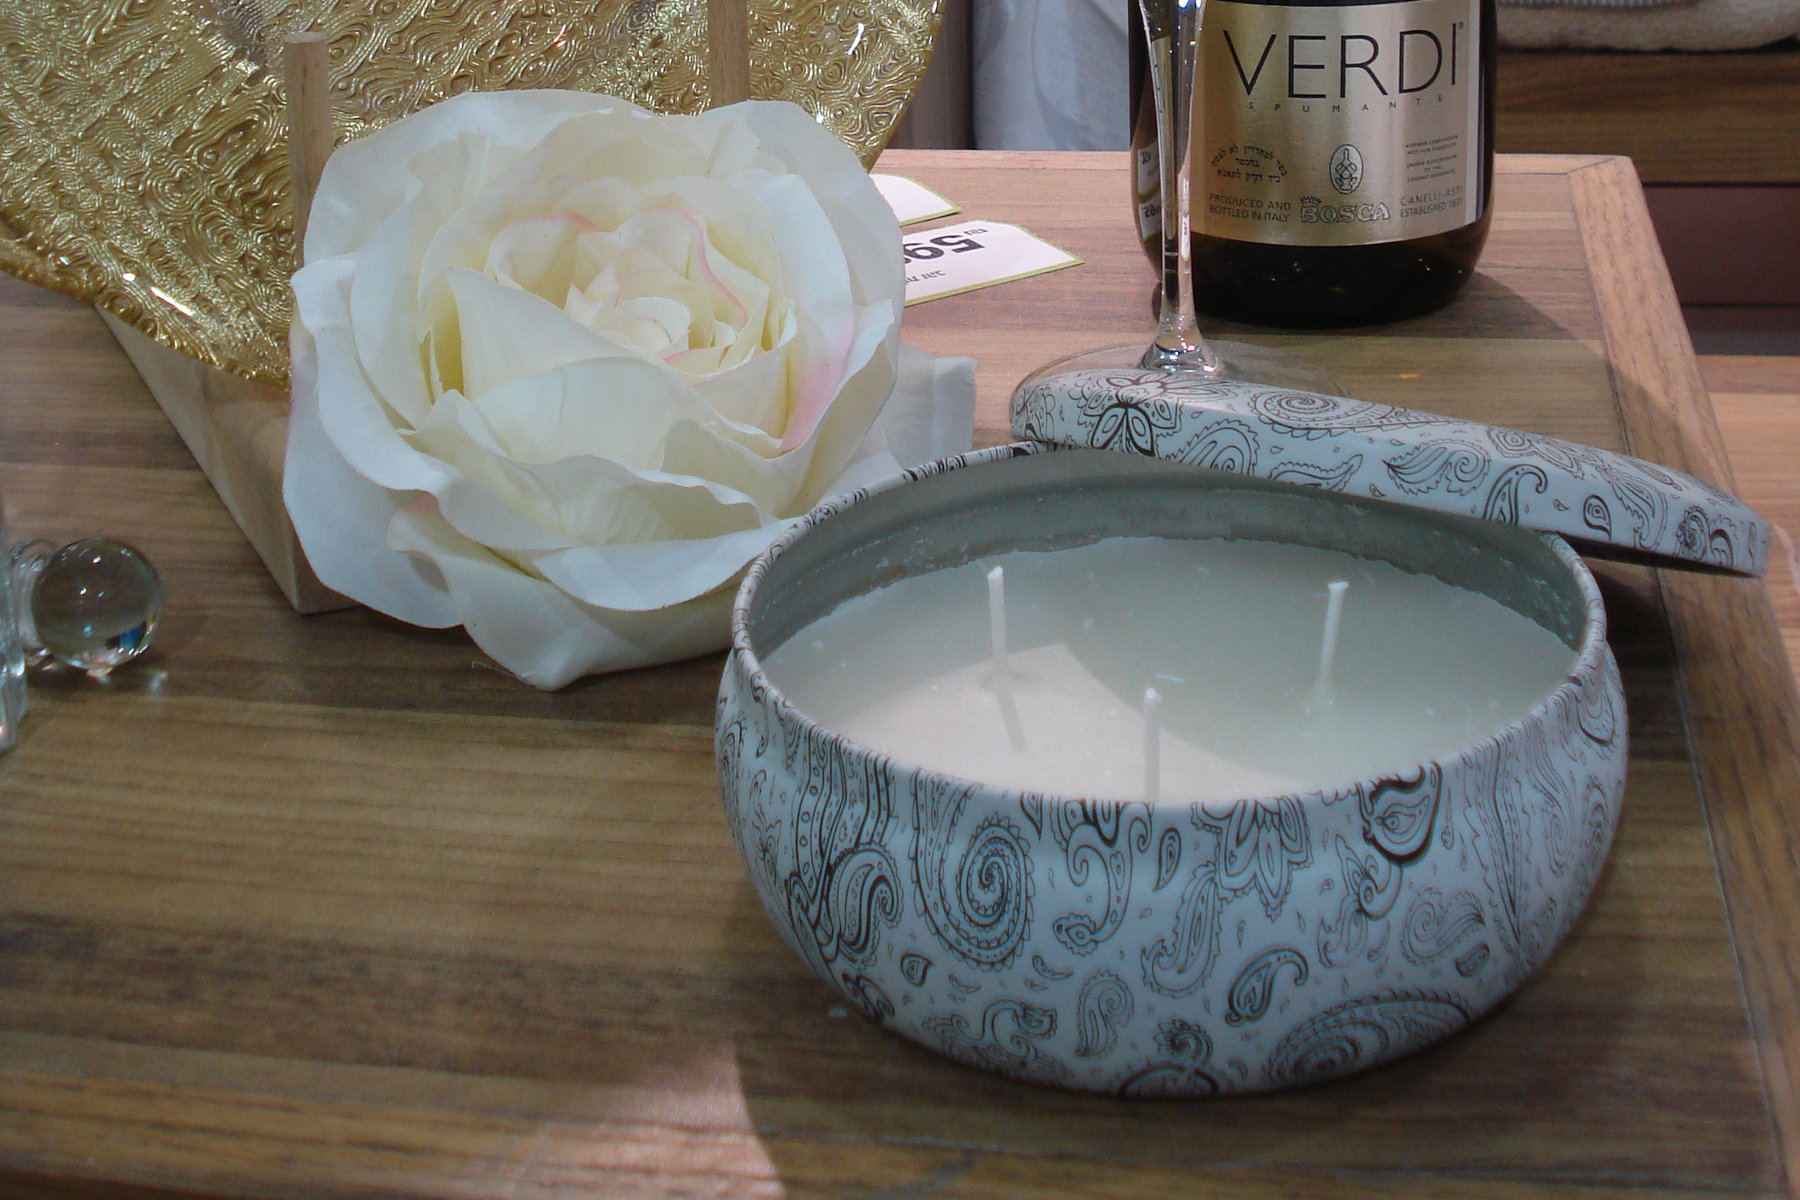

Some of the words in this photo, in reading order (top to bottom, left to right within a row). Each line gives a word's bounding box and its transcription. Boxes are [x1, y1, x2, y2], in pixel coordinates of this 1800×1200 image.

[1223, 22, 1457, 99] VERDI
[1248, 95, 1443, 113] SPUMANTE
[1209, 192, 1263, 209] PRODUCED
[1267, 200, 1291, 211] AND
[1209, 204, 1249, 219] BOTTLED
[1252, 211, 1261, 220] IN
[1264, 212, 1290, 222] ITALY
[1300, 201, 1391, 224] BOSCA
[903, 235, 985, 264] 59
